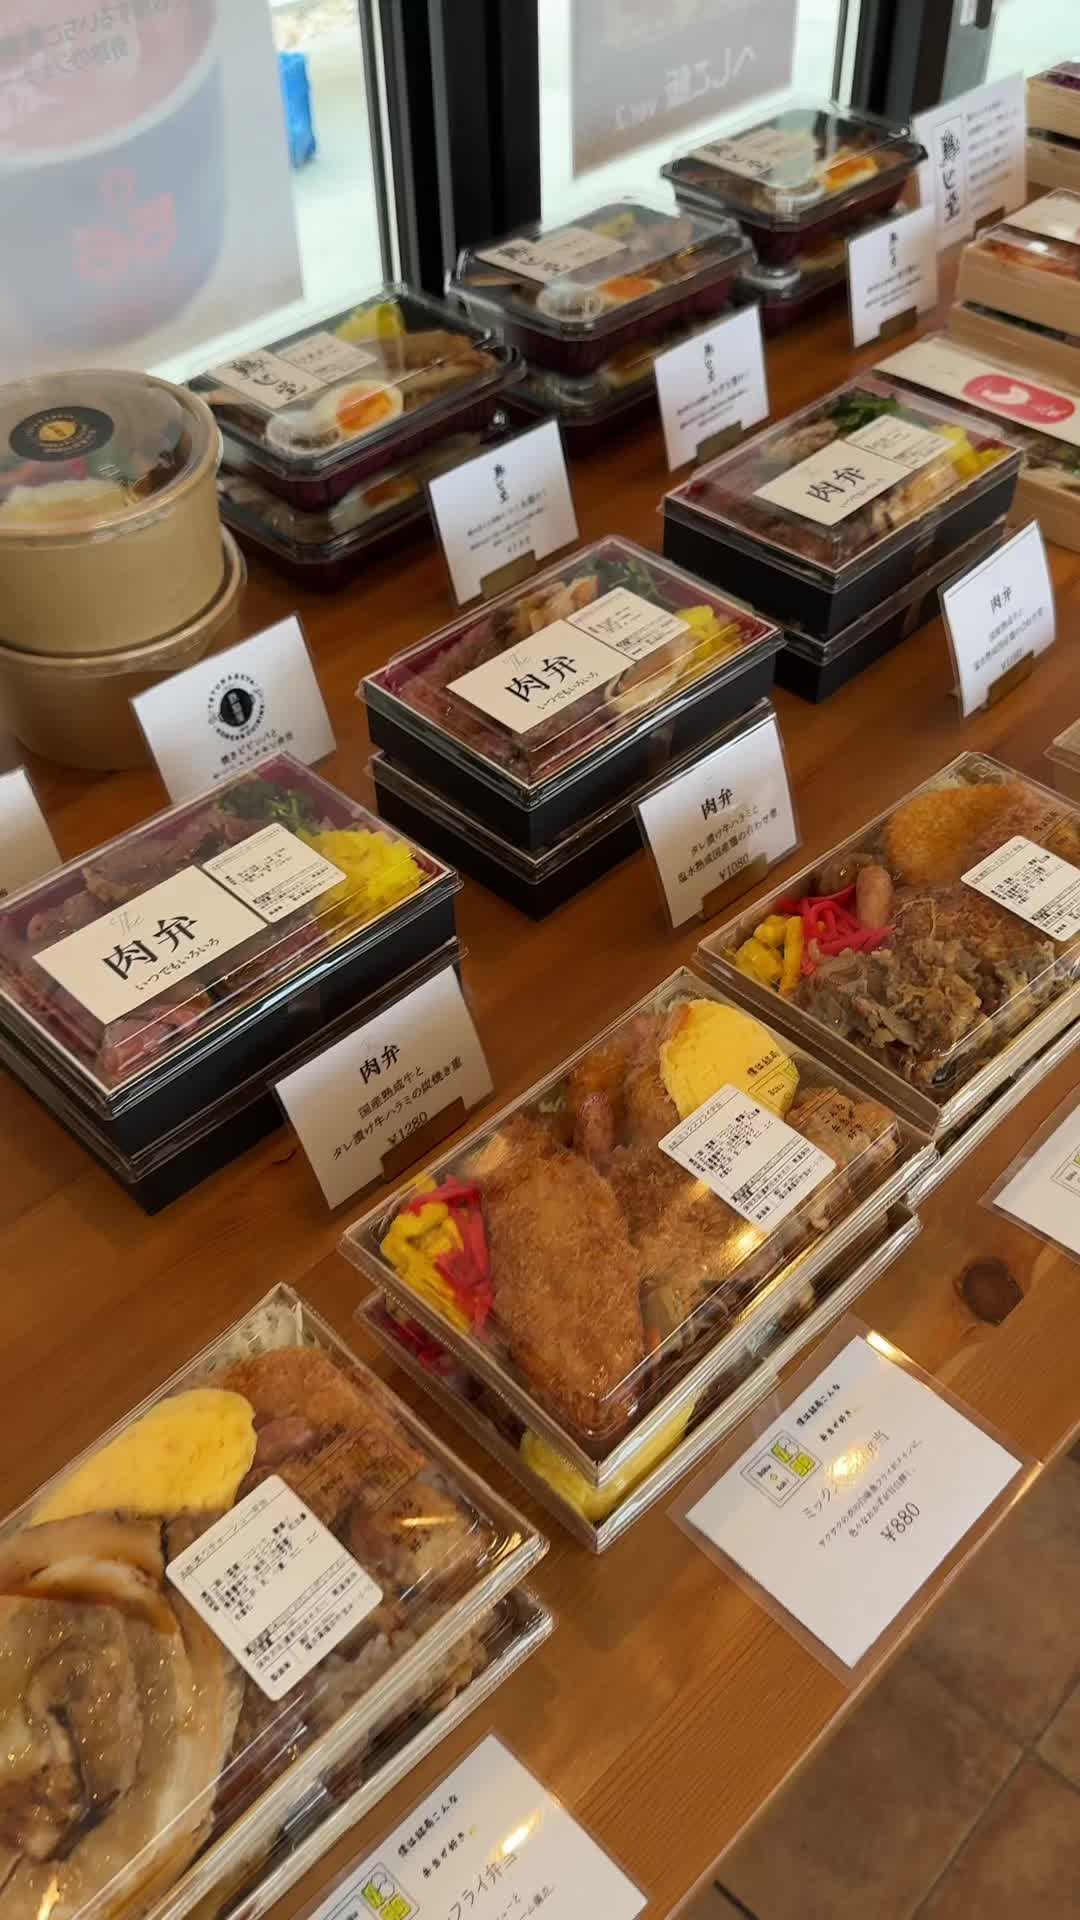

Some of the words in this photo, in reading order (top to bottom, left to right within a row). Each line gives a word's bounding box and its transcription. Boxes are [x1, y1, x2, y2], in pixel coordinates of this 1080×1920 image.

[806, 464, 862, 502] 肉弁
[506, 655, 577, 703] 肉弁
[701, 788, 734, 819] 肉弁
[102, 914, 198, 981] 肉弁
[134, 937, 221, 992] いつでもいろいろ
[360, 1044, 400, 1084] 肉弁
[358, 1066, 424, 1120] 国産熟成牛と
[388, 1111, 429, 1147] ¥1280
[880, 1502, 922, 1543] ¥880
